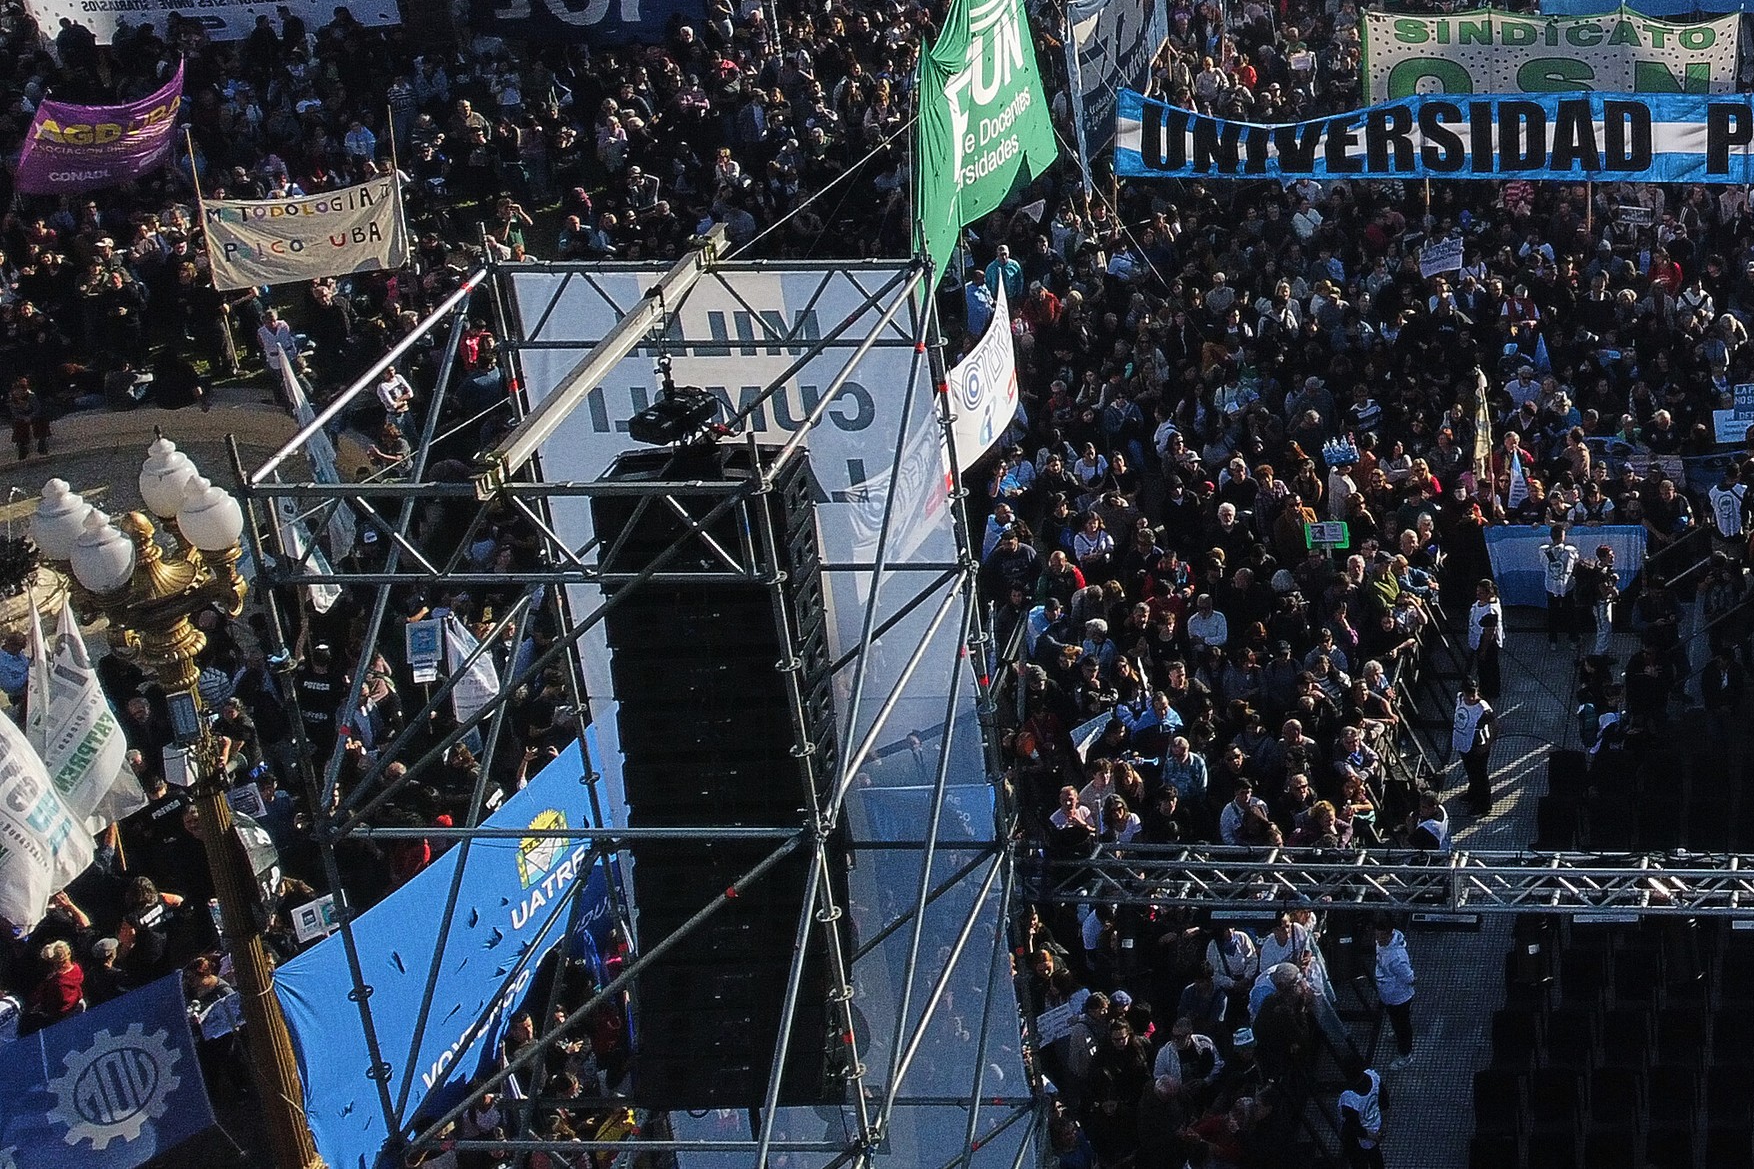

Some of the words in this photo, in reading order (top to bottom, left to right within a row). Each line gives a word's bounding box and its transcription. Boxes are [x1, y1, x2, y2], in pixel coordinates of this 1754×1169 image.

[1393, 17, 1718, 52] SINDICATO
[34, 119, 122, 145] AGD
[978, 86, 1032, 144] Docentes
[1139, 94, 1654, 177] UNIVERSIDAD
[328, 221, 383, 249] UBA
